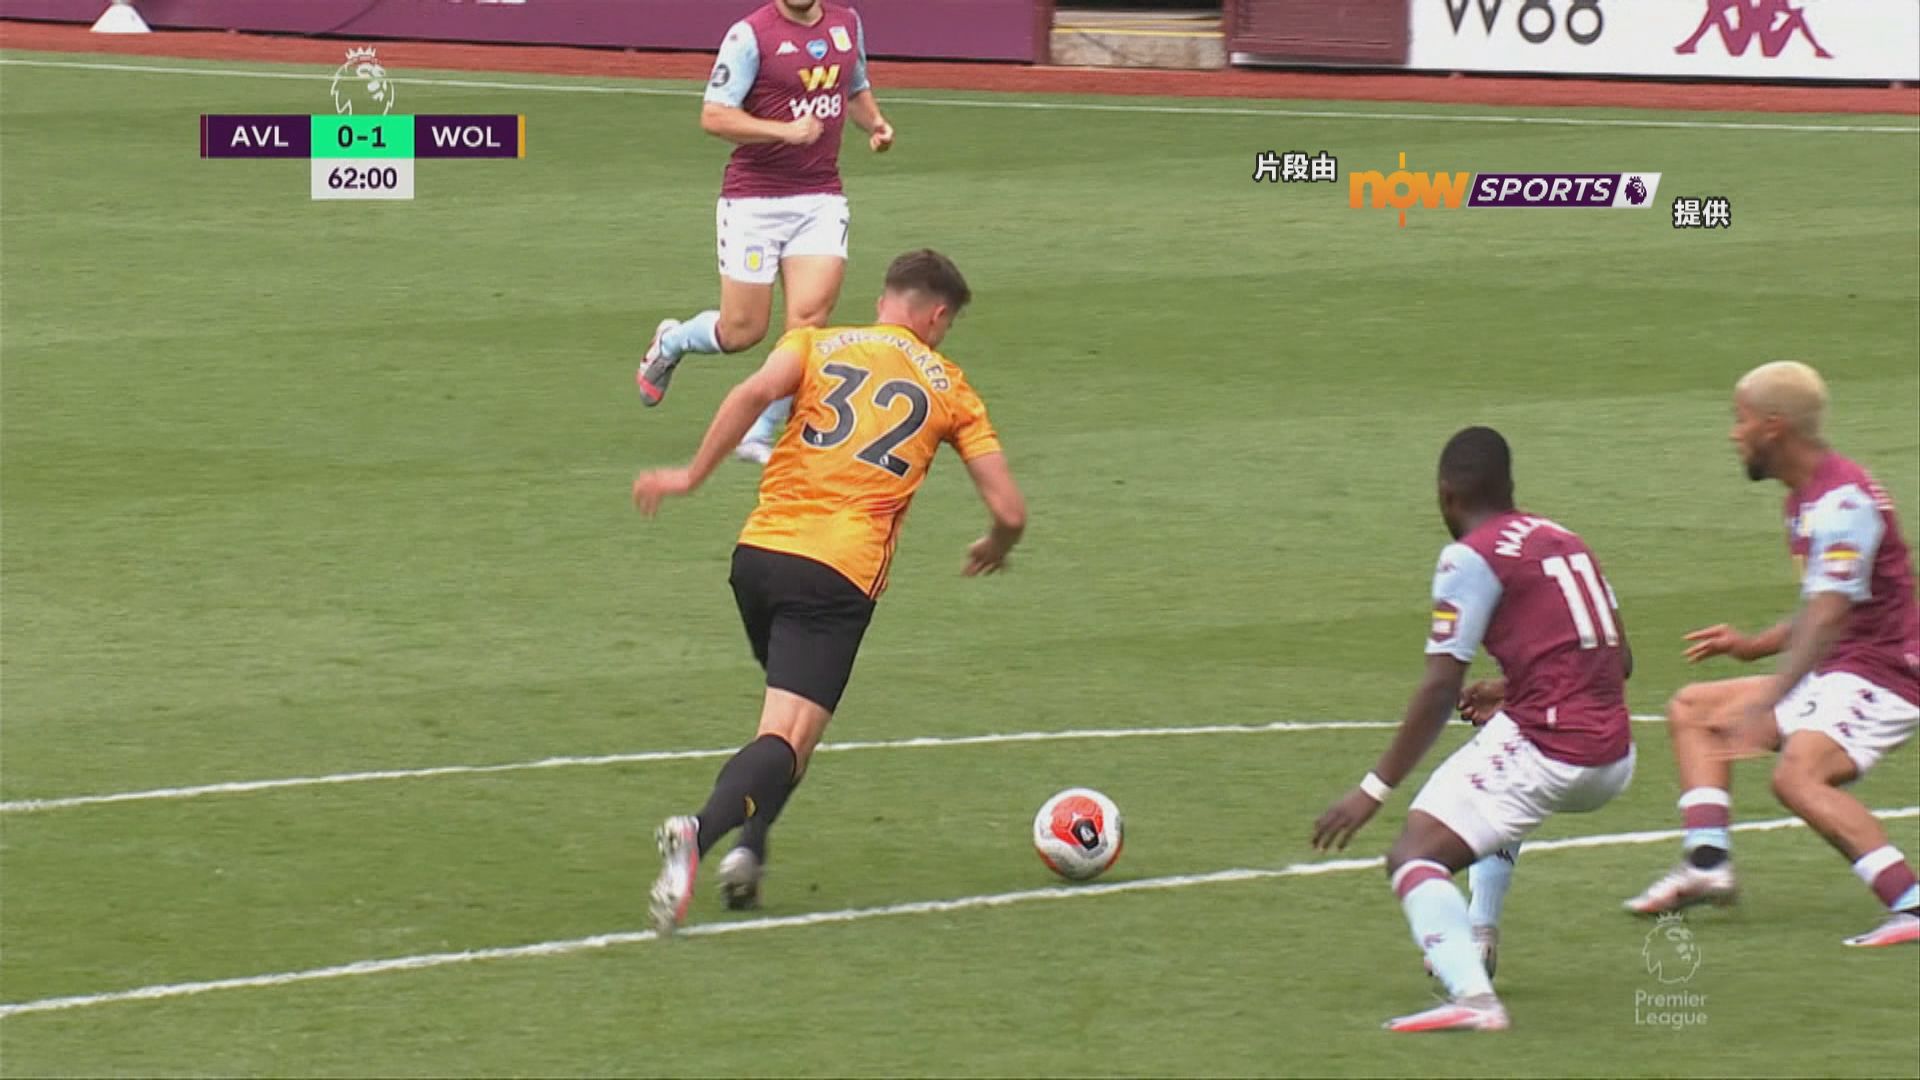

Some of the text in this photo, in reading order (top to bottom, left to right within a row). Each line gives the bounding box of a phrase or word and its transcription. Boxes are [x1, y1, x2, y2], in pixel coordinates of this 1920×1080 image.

[789, 94, 843, 120] W88
[800, 361, 932, 478] 32
[1542, 553, 1619, 648] 11
